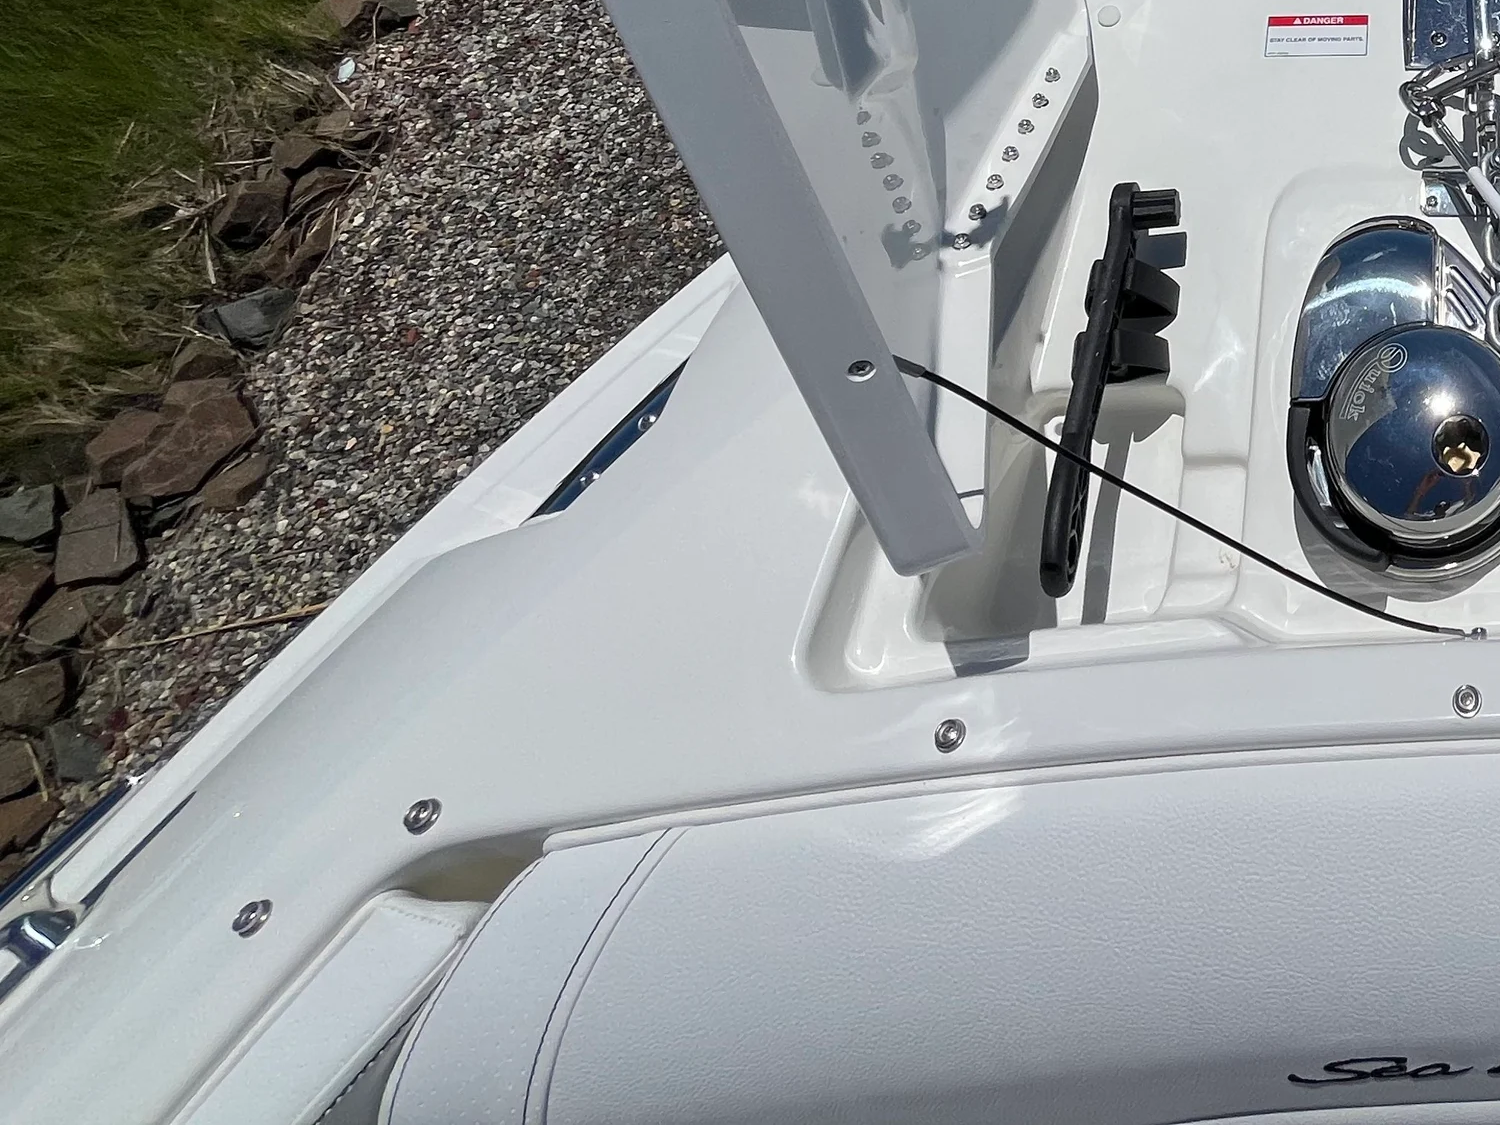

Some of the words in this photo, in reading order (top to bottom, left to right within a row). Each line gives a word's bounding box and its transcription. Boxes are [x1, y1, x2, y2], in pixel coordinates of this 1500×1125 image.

[1303, 17, 1344, 25] DANGER
[1339, 342, 1408, 421] Quick
[1287, 1056, 1474, 1084] Sea
